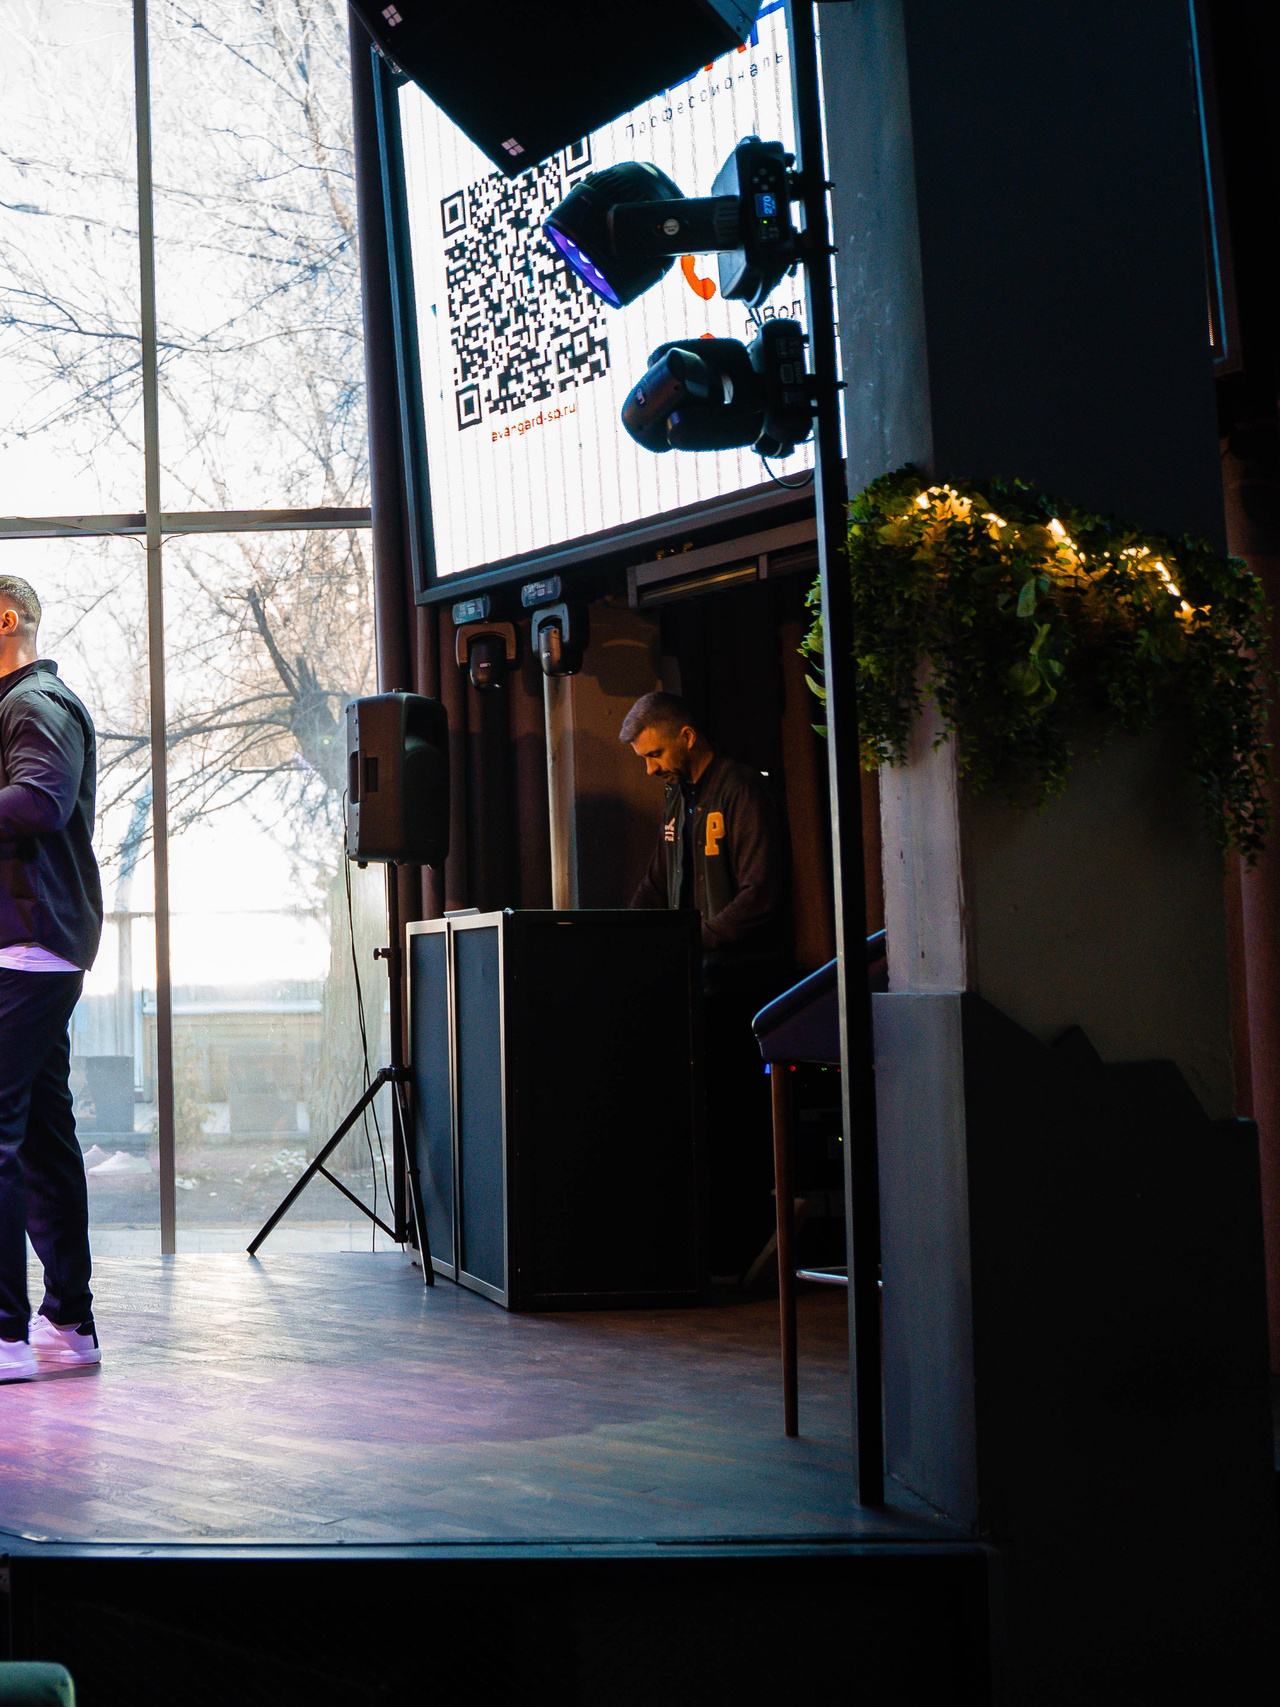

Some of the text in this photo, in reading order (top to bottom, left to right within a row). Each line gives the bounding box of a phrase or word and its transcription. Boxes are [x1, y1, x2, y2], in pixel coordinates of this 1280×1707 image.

[763, 195, 773, 214] 270
[491, 403, 576, 442] avangard-sp.ru
[704, 811, 726, 856] P
